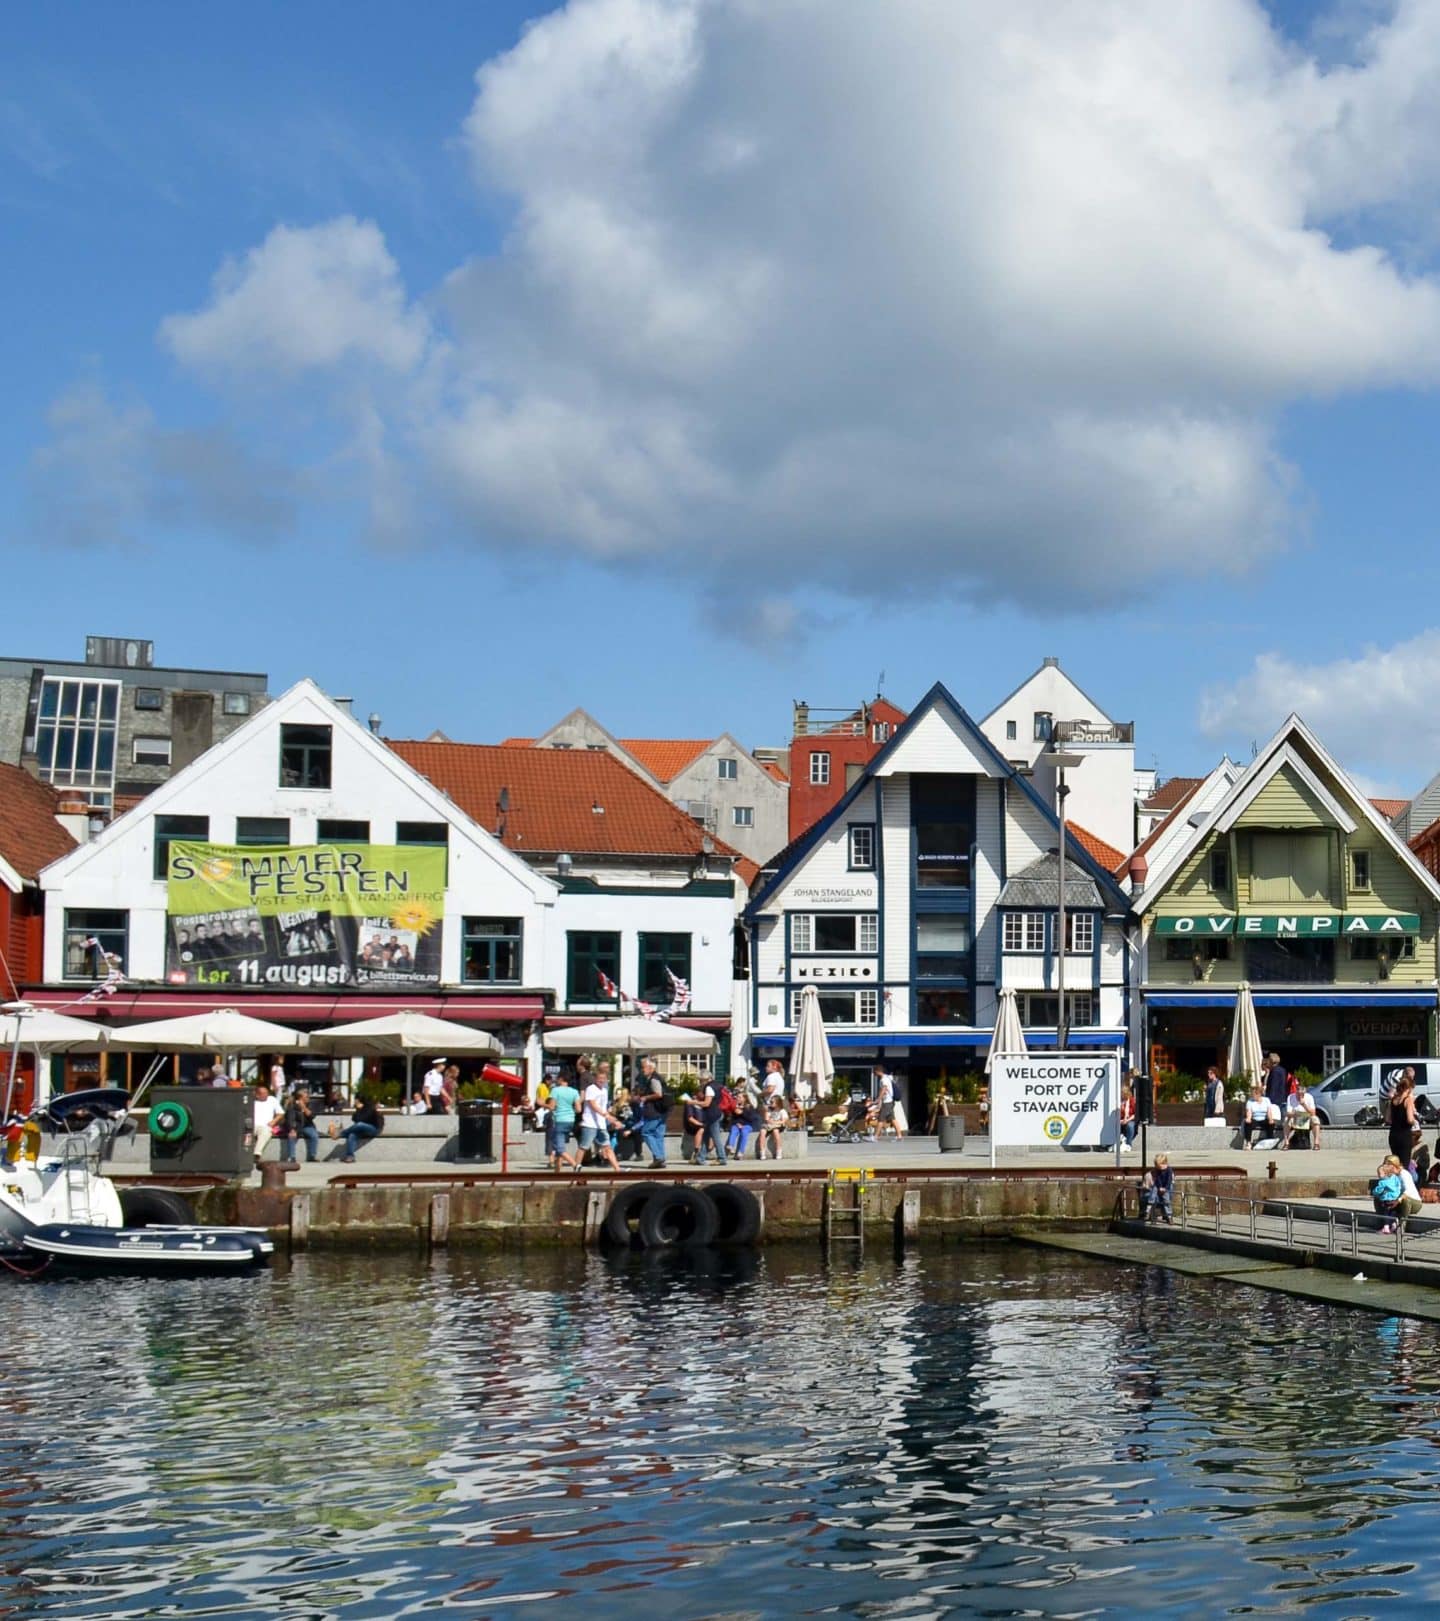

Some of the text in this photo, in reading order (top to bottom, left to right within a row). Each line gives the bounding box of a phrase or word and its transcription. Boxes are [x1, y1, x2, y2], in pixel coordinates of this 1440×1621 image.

[250, 870, 409, 896] FESTEN
[793, 888, 873, 897] JOHAN STANGELAND
[250, 895, 289, 906] VISTE
[1174, 917, 1404, 932] OVENPAA
[798, 967, 871, 977] MEXIKO
[1006, 1067, 1106, 1079] WELCOME TO
[1024, 1084, 1087, 1096] PORT OF
[1013, 1101, 1099, 1113] STAVANGER
